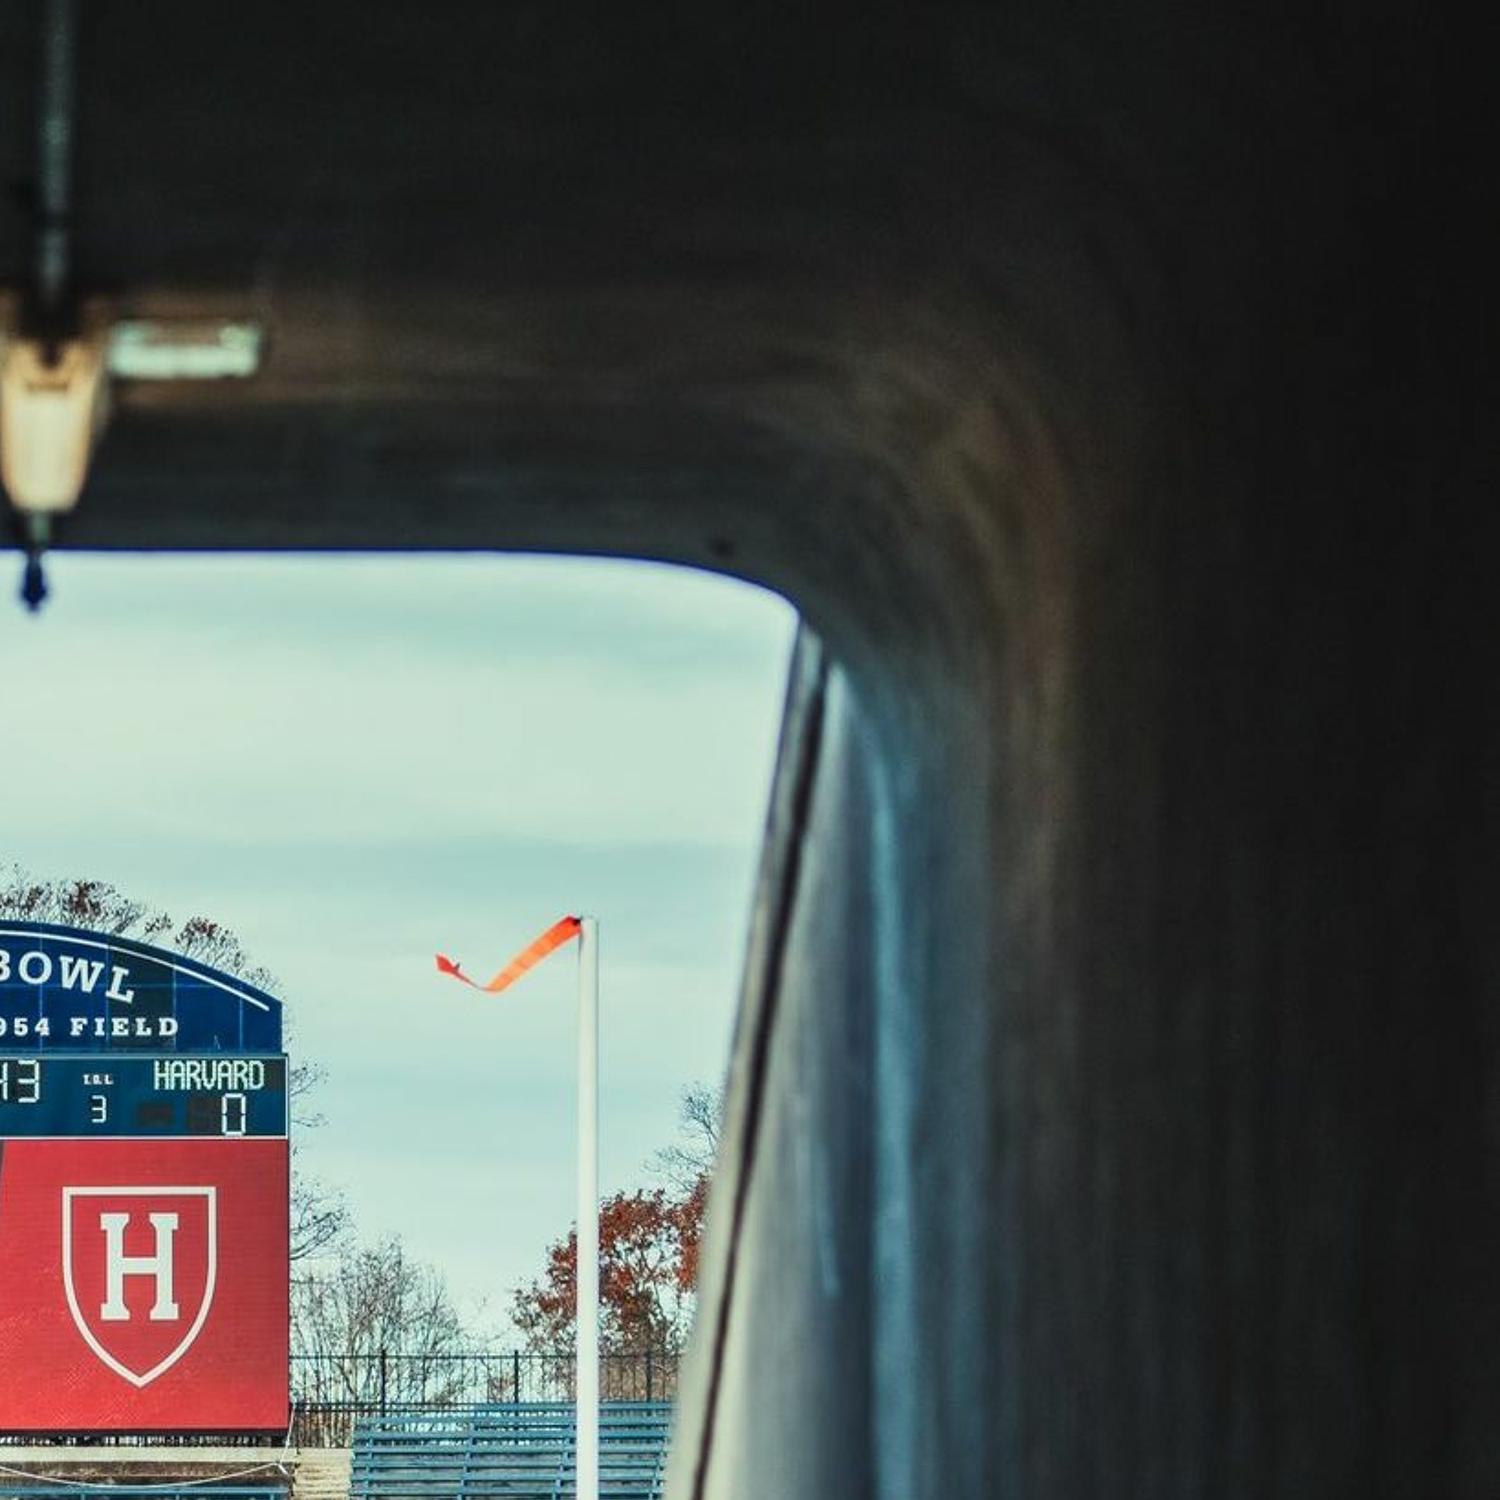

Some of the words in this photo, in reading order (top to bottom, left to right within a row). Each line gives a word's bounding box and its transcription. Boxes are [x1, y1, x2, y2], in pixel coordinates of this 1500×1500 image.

[70, 1016, 179, 1037] FIELD
[154, 1060, 264, 1090] HARVARD
[92, 1095, 107, 1123] 3
[221, 1093, 246, 1136] 0
[100, 1212, 179, 1321] H
